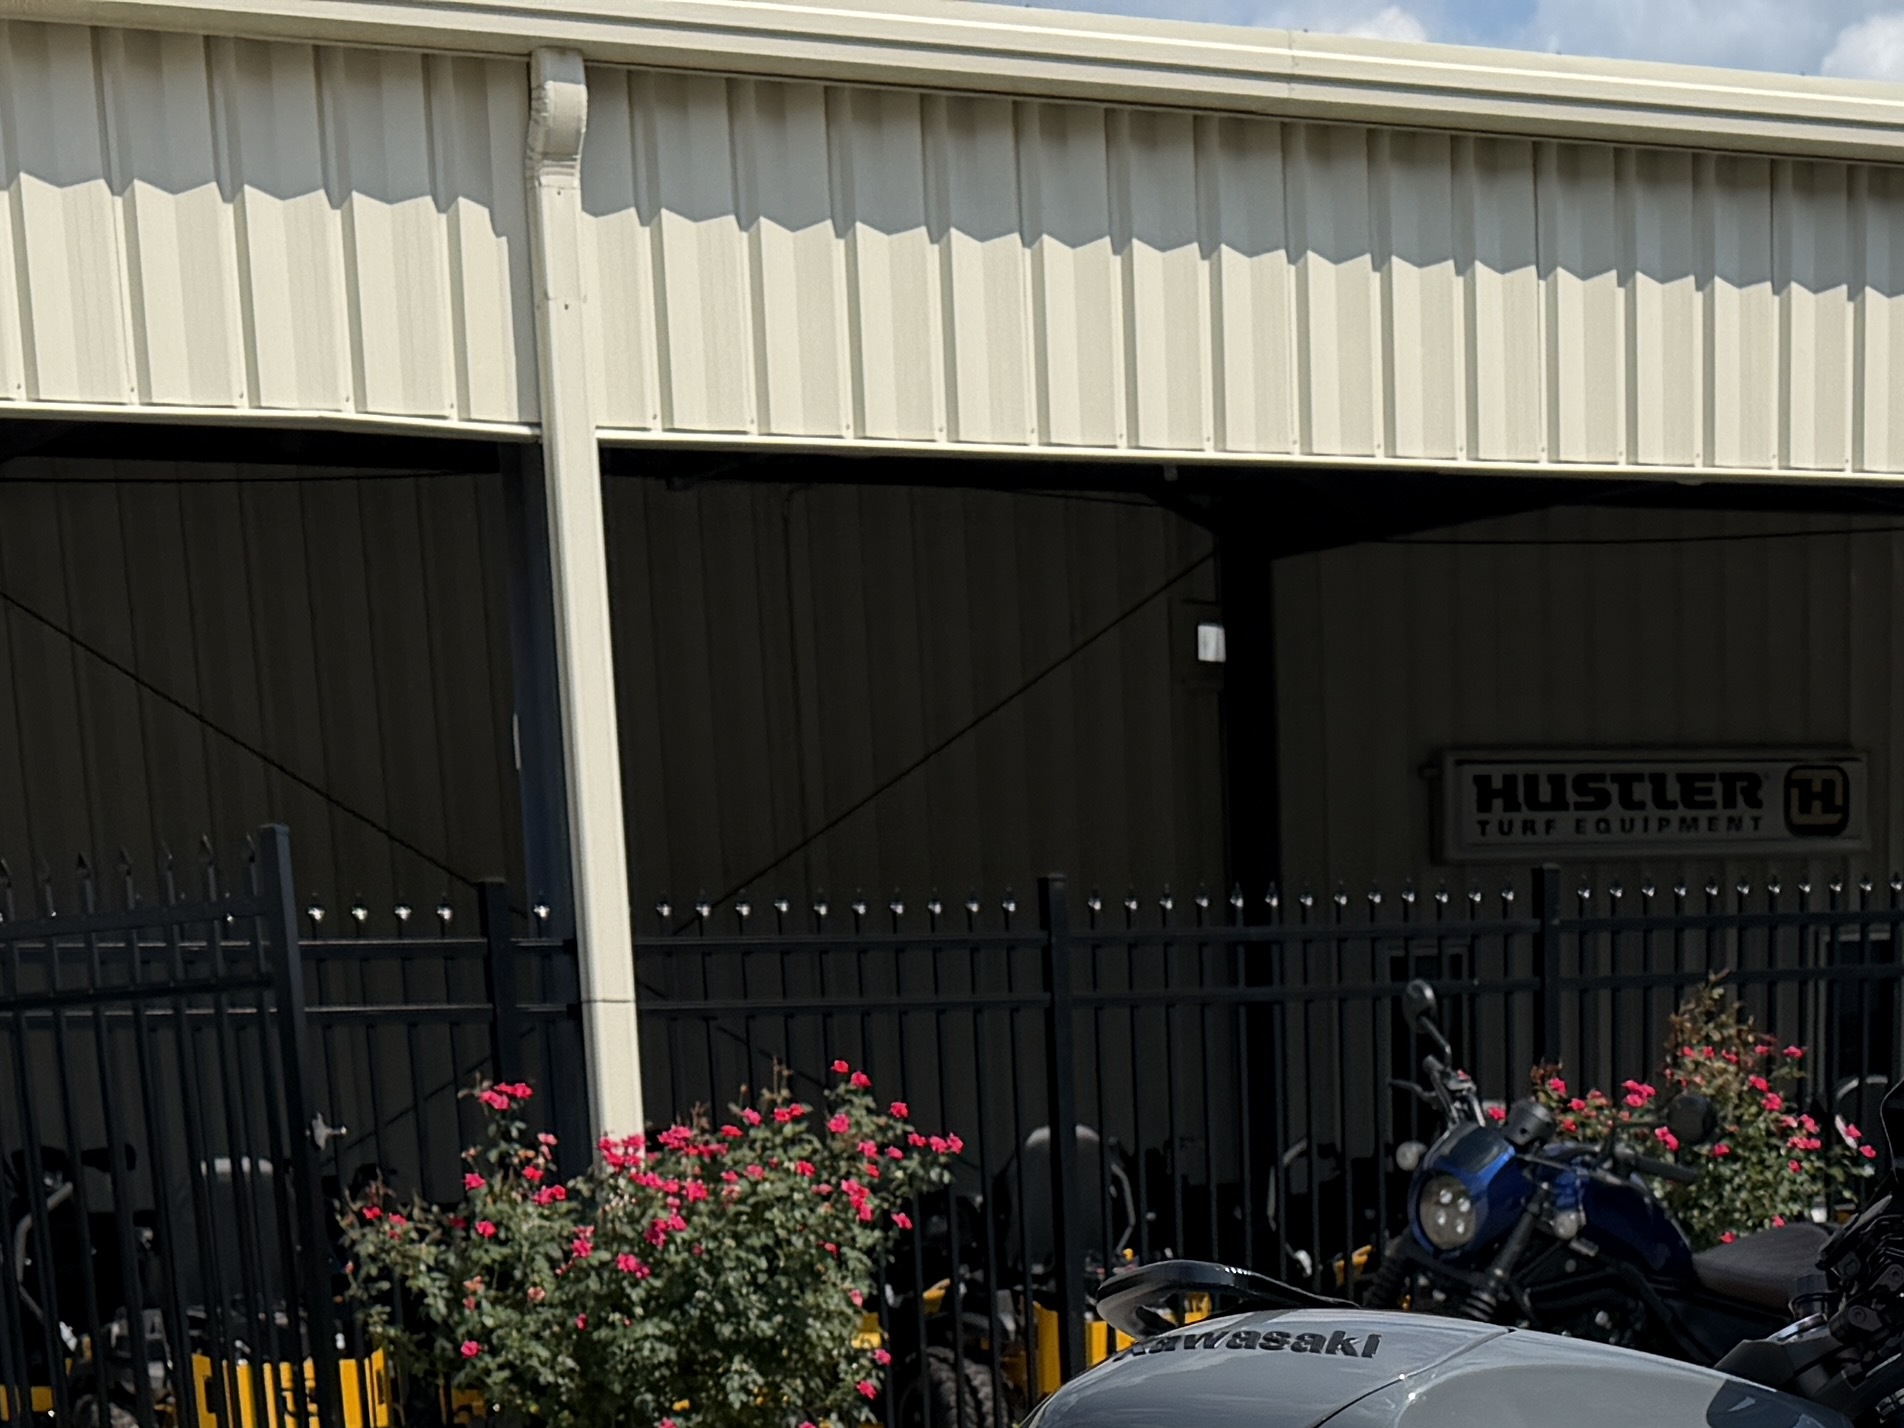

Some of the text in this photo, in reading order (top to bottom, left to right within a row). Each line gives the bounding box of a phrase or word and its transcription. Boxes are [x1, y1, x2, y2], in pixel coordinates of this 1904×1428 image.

[1473, 771, 1764, 814] HUSTLER
[1477, 813, 1763, 837] TURF EQUIPMENT
